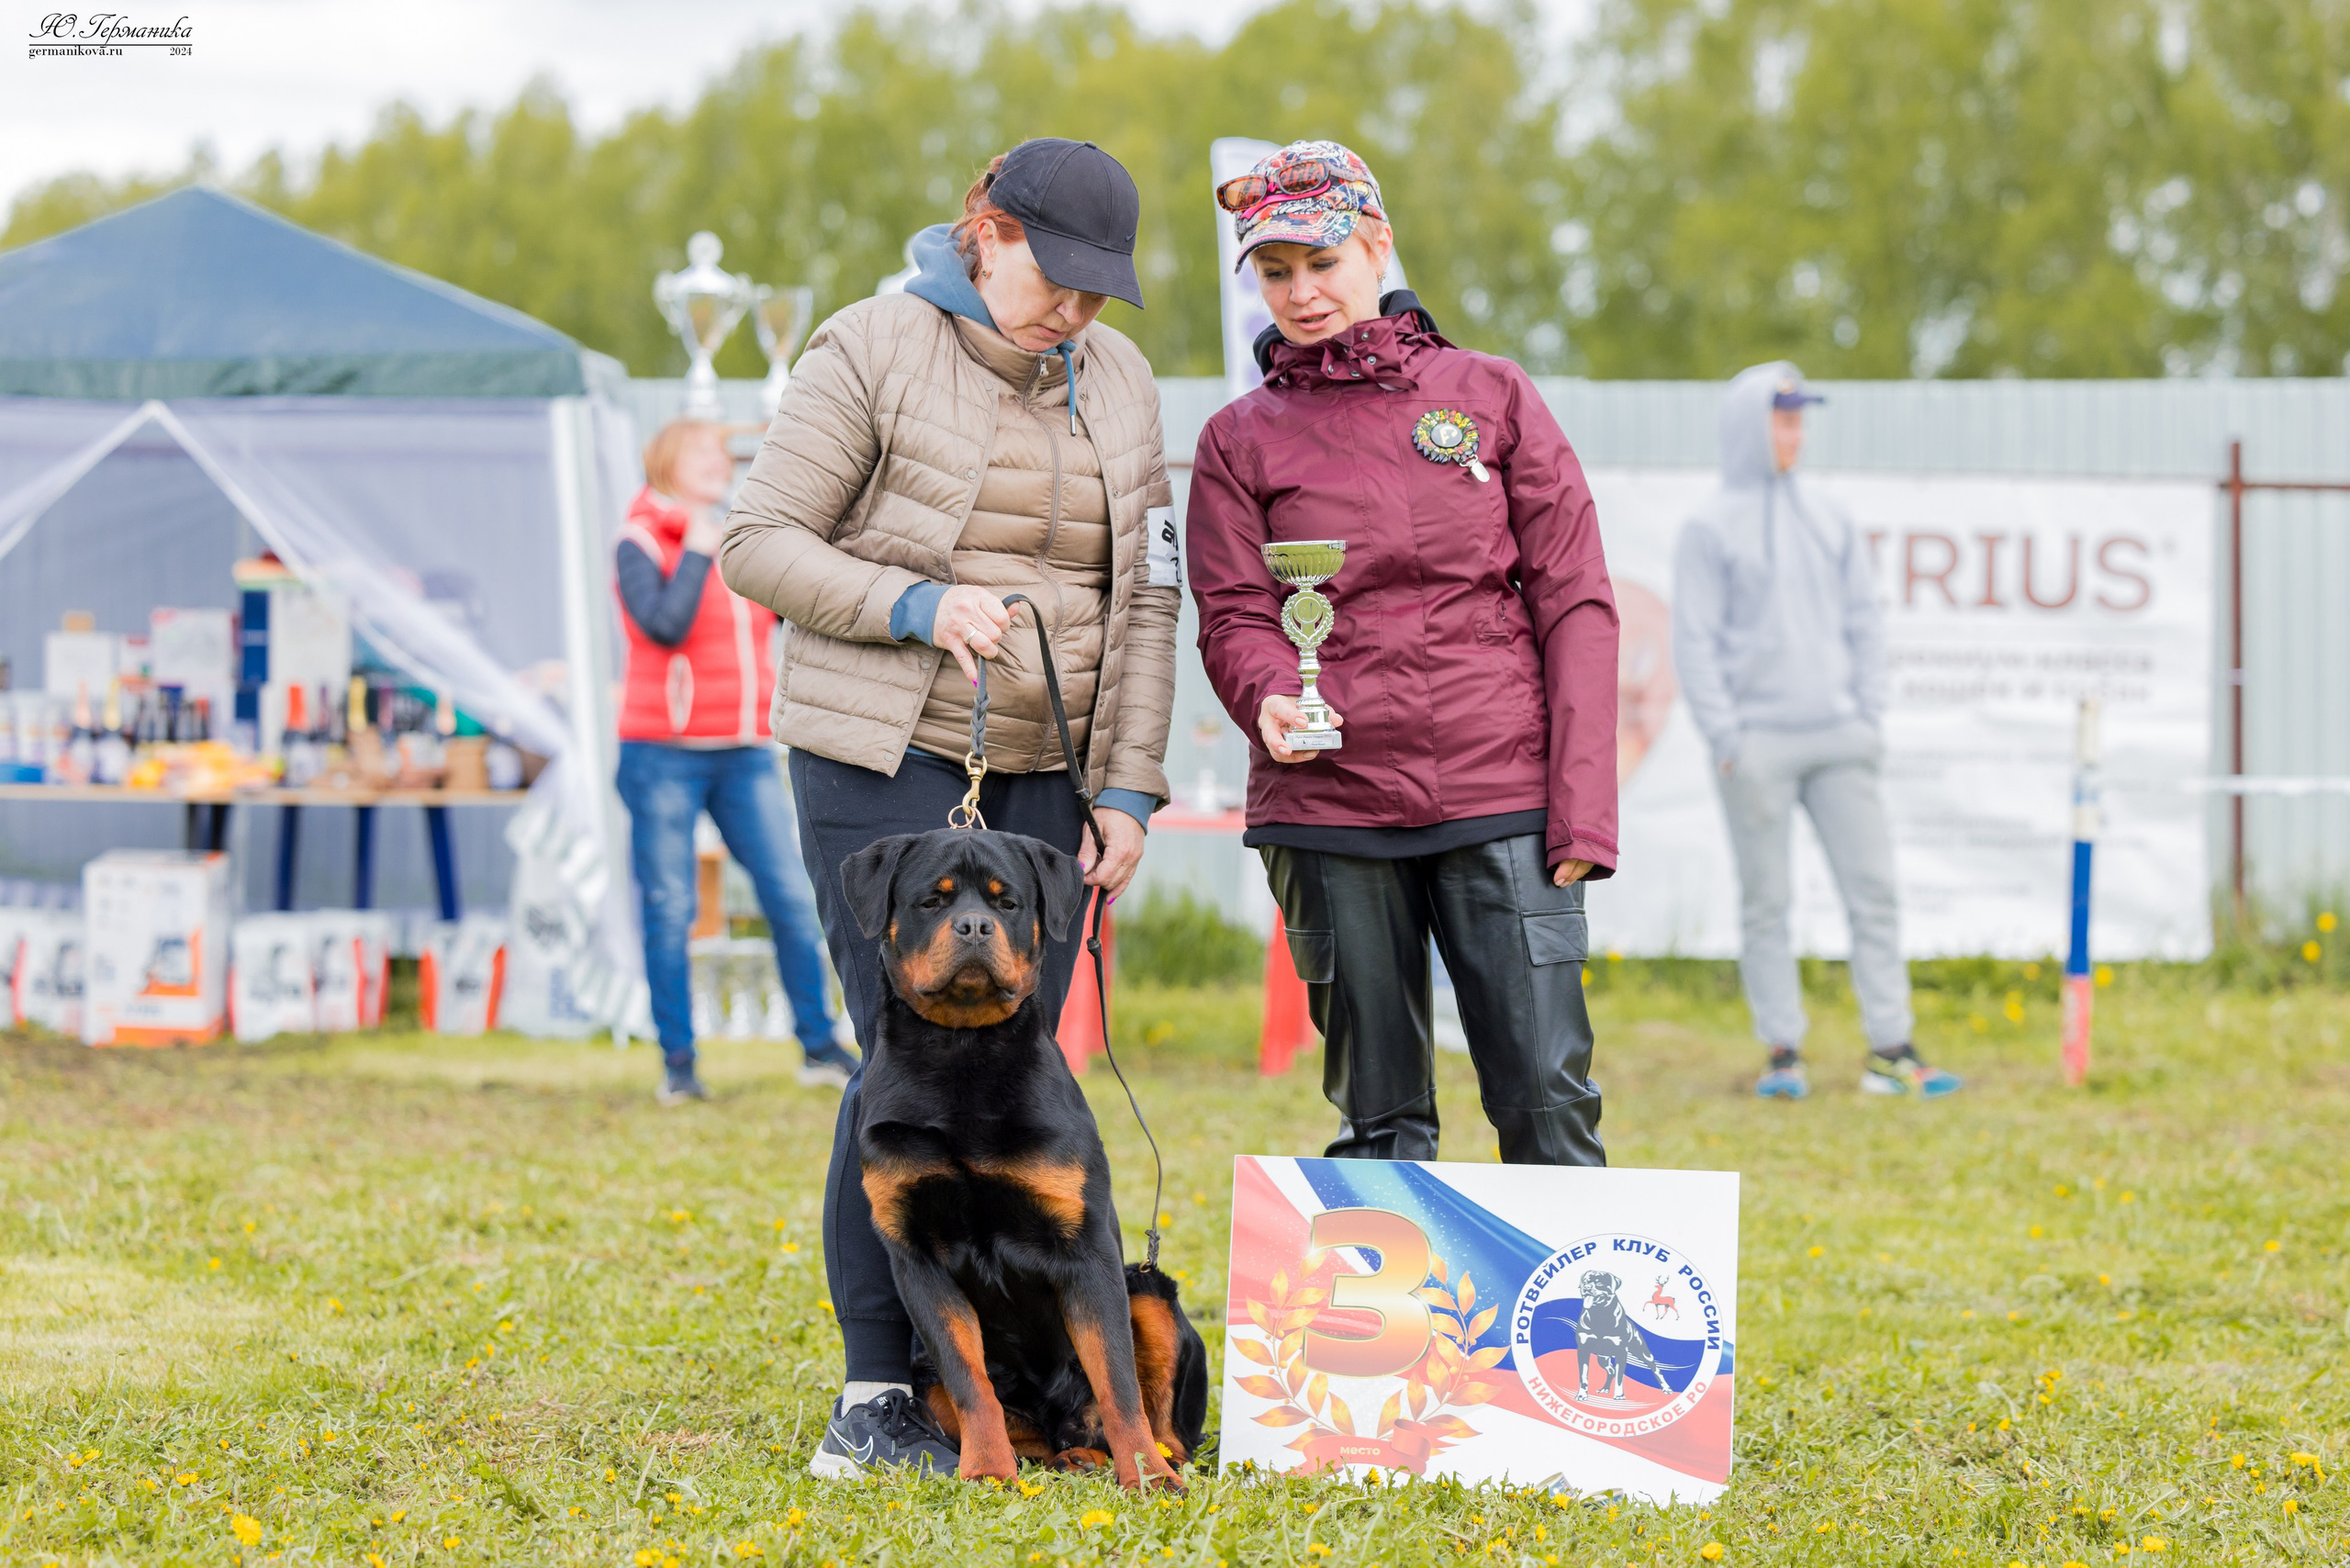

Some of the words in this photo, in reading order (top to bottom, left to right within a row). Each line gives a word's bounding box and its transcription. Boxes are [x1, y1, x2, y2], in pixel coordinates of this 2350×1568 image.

[1303, 1206, 1433, 1377] 3
[1516, 1241, 1597, 1344] РОТВЕЙЛЕР
[1613, 1238, 1671, 1262] КЛУБ
[1678, 1264, 1720, 1350] РОССИИ
[1528, 1376, 1685, 1437] НИЖЕГОРОДСКОЕ
[1686, 1381, 1707, 1405] РО
[1340, 1446, 1381, 1456] место
